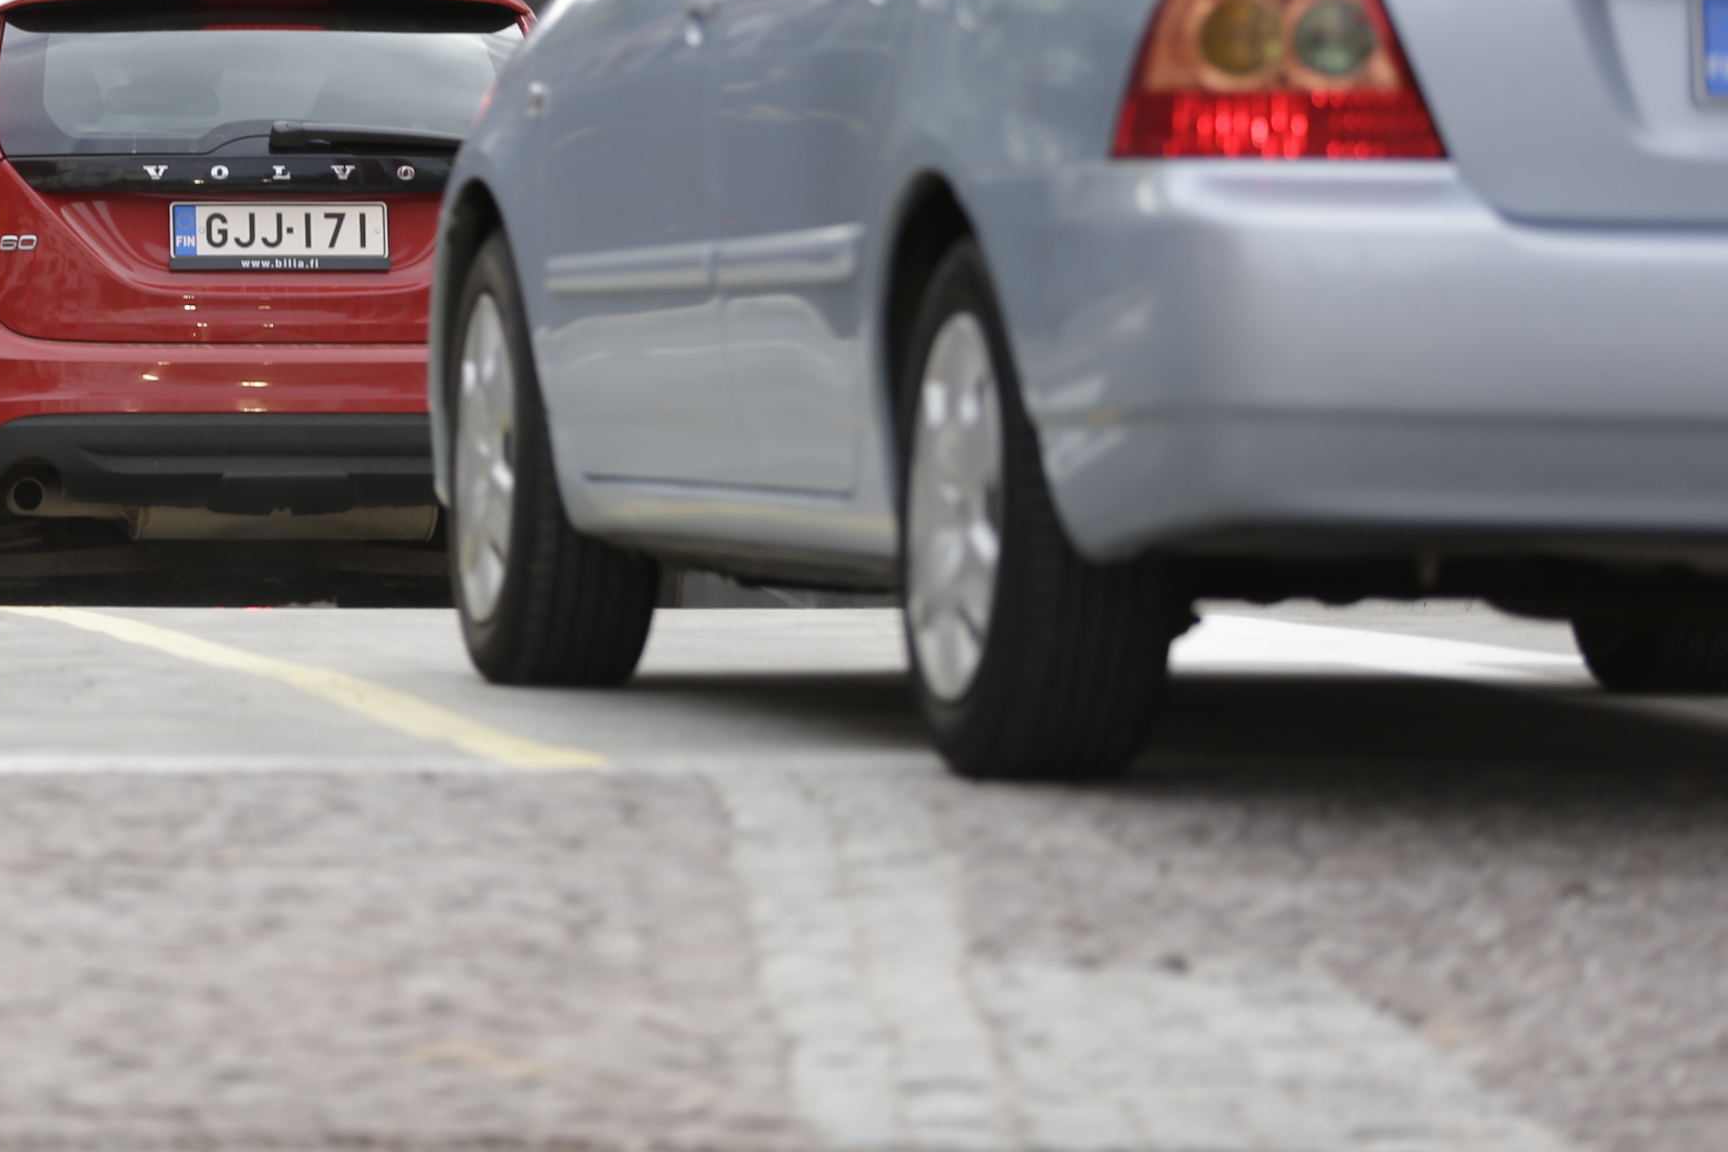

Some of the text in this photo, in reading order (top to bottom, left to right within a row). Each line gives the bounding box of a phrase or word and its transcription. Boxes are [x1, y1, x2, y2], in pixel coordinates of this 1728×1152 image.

[143, 164, 416, 181] VOLVO
[205, 212, 367, 249] GJJ-171
[175, 235, 196, 247] FIN
[241, 257, 319, 269] www.bilia.fi
